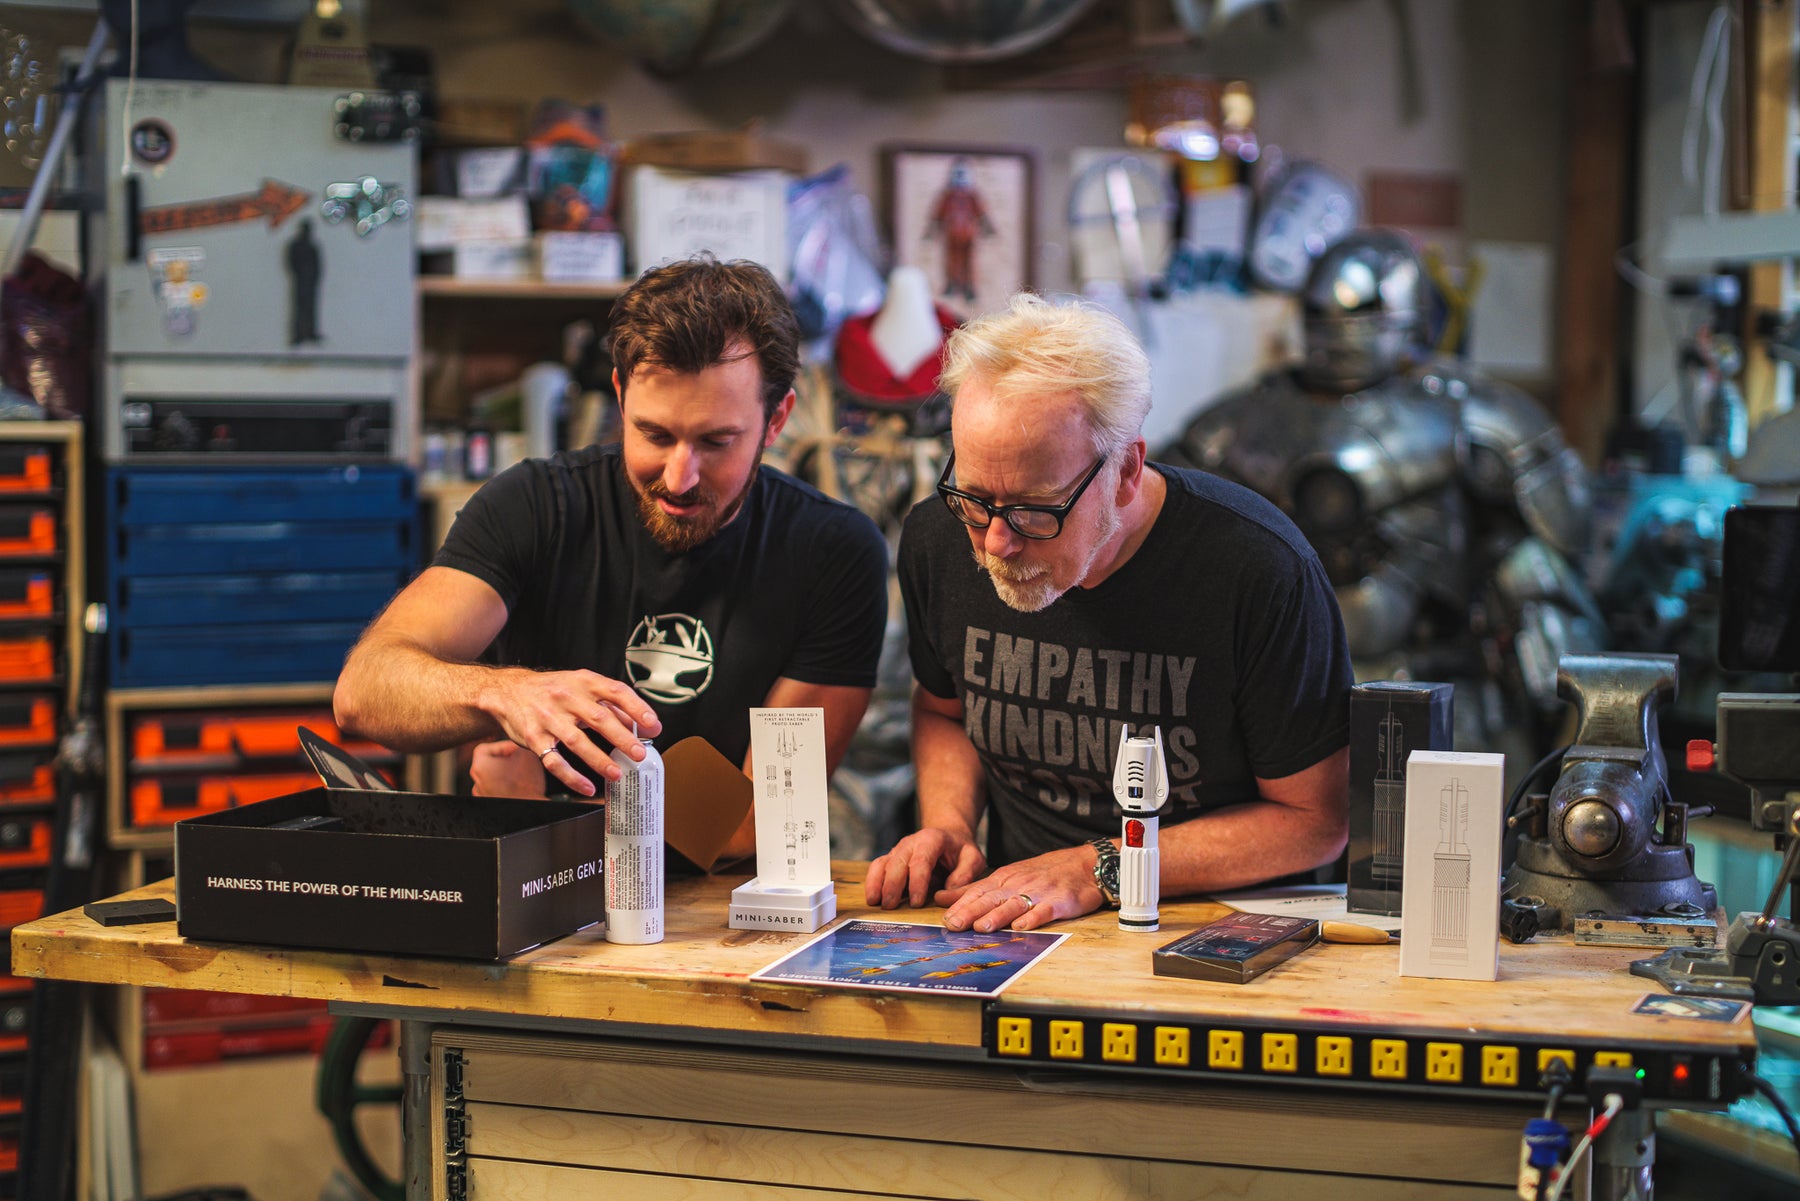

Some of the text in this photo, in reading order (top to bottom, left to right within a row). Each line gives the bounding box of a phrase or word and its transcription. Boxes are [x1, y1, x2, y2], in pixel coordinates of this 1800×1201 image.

[964, 625, 1198, 717] EMPATHY
[964, 688, 1201, 780] KINDNS
[207, 876, 463, 903] HARNESS THE POWER OF THE MINI-SABER
[522, 858, 604, 898] MINI-SABER GEN 2
[735, 913, 804, 925] MINI-SABER
[778, 973, 979, 992] WORLD'S FIRST PROTOSABER
